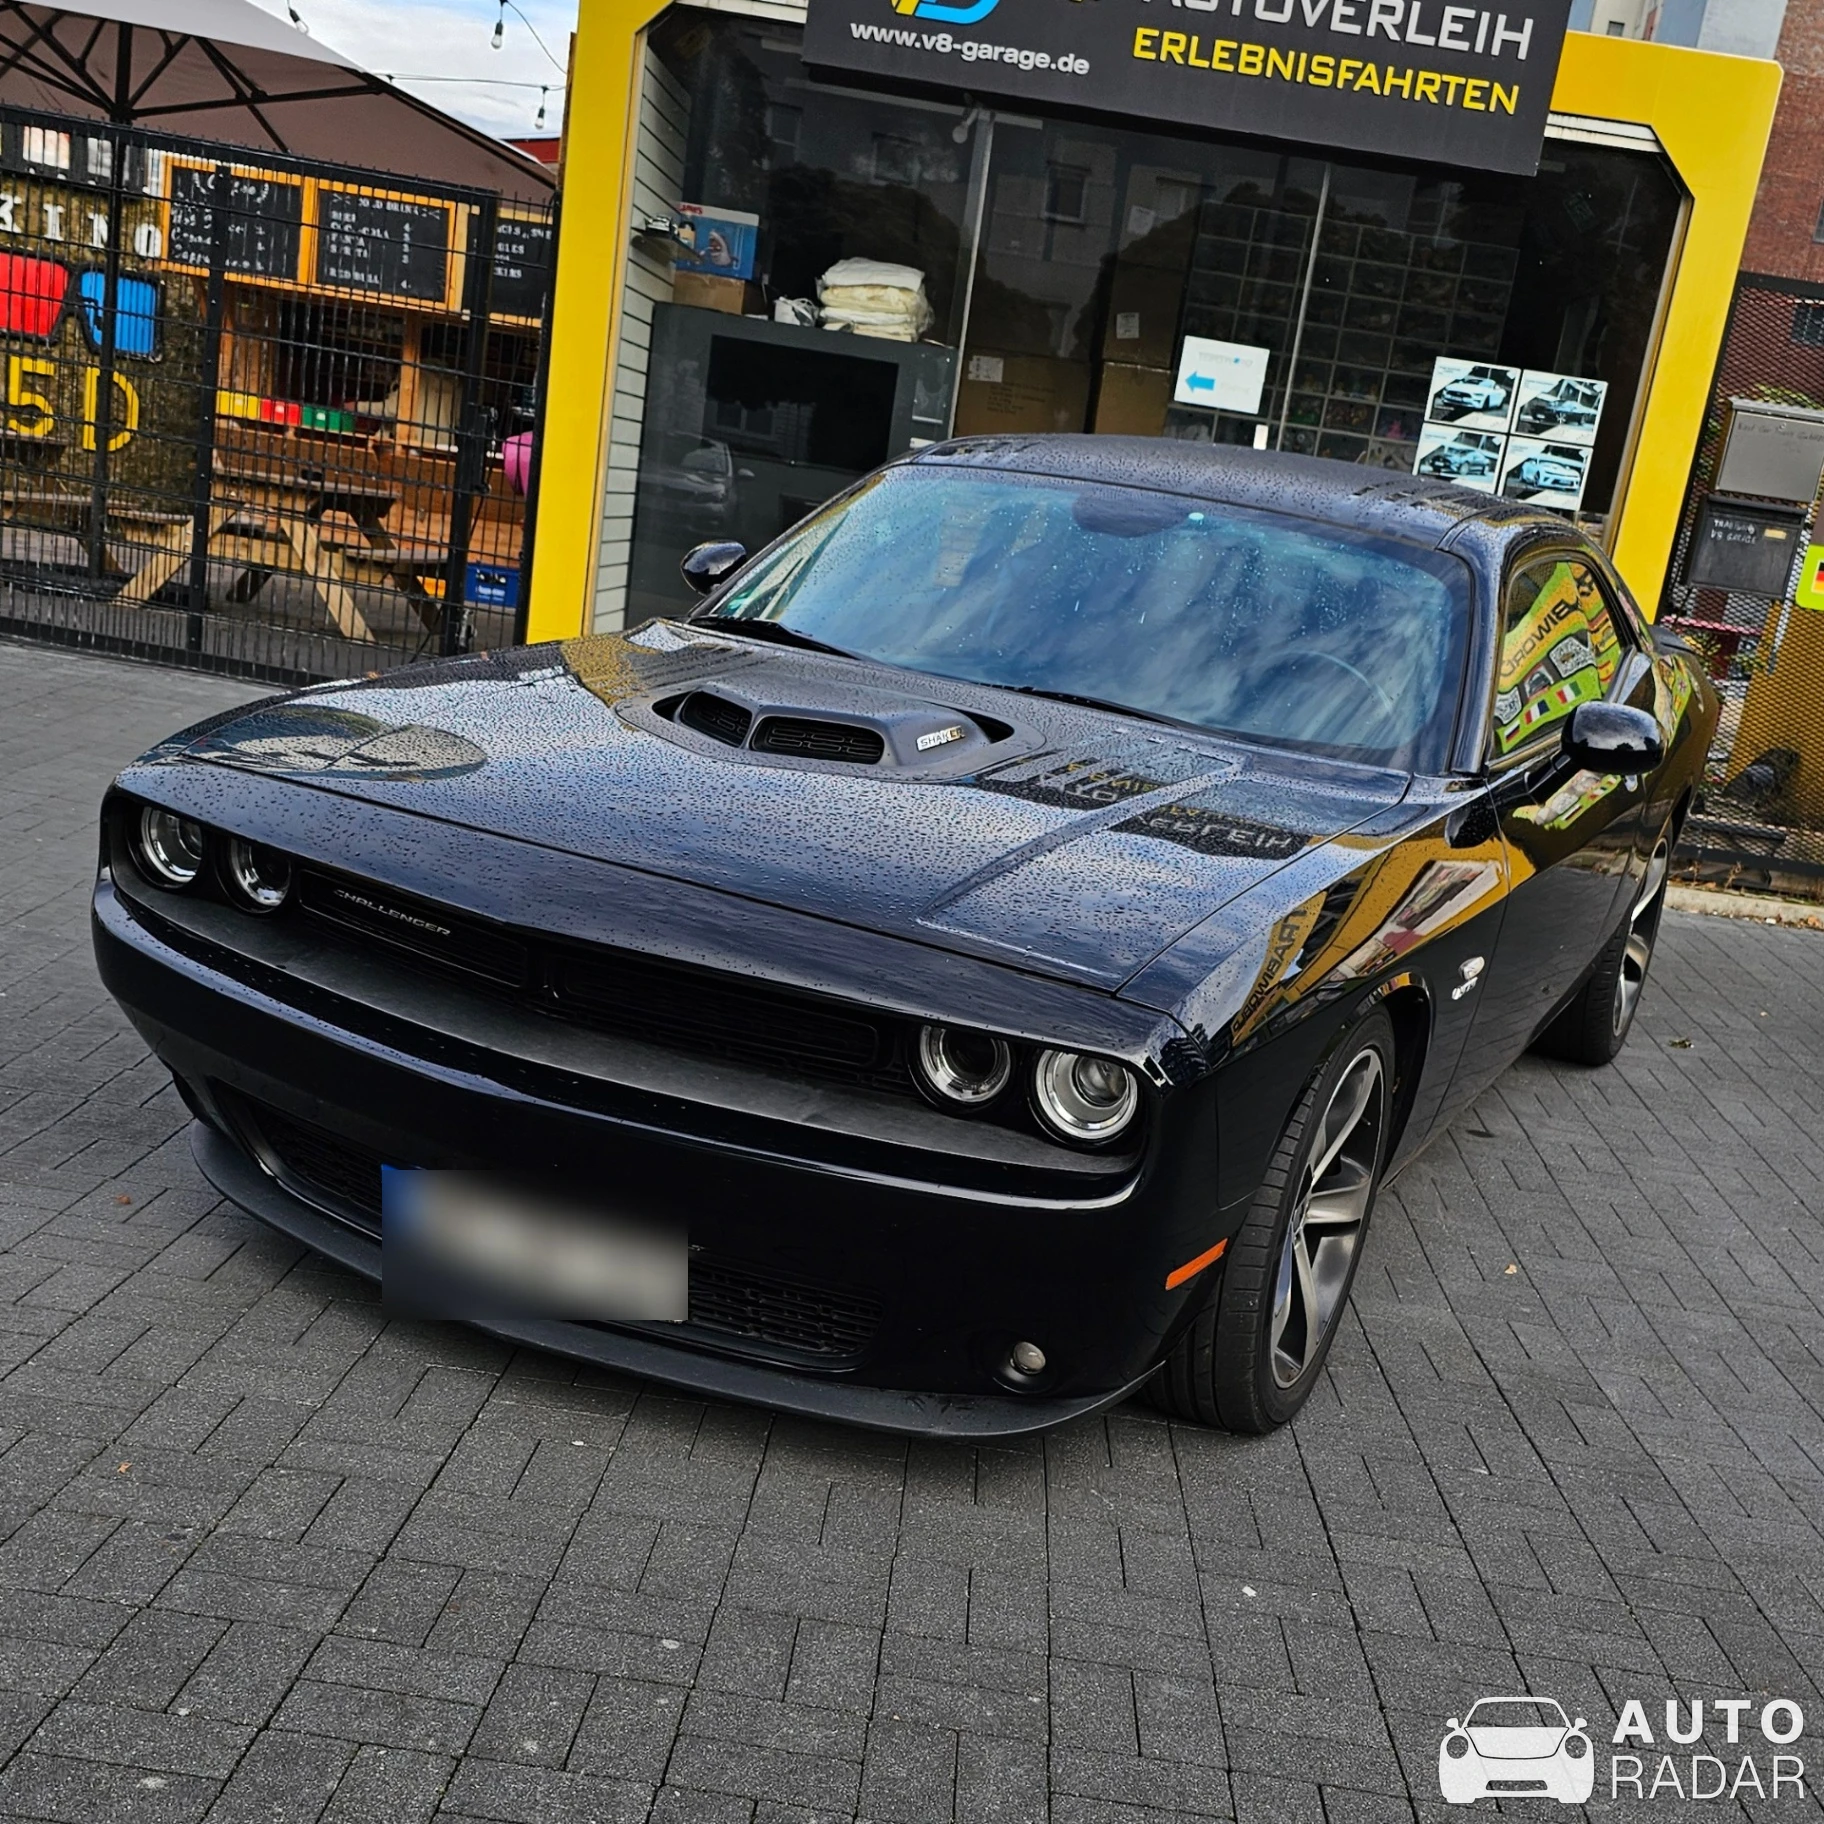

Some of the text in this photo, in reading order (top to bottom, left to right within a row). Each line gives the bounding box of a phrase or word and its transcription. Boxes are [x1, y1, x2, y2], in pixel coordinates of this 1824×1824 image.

[849, 22, 1091, 76] www.v8-garage.de
[1142, 0, 1534, 61] OVERLEIH
[1132, 26, 1520, 116] ERLEBNISFAHRTEN
[334, 889, 451, 935] CHALLENGER
